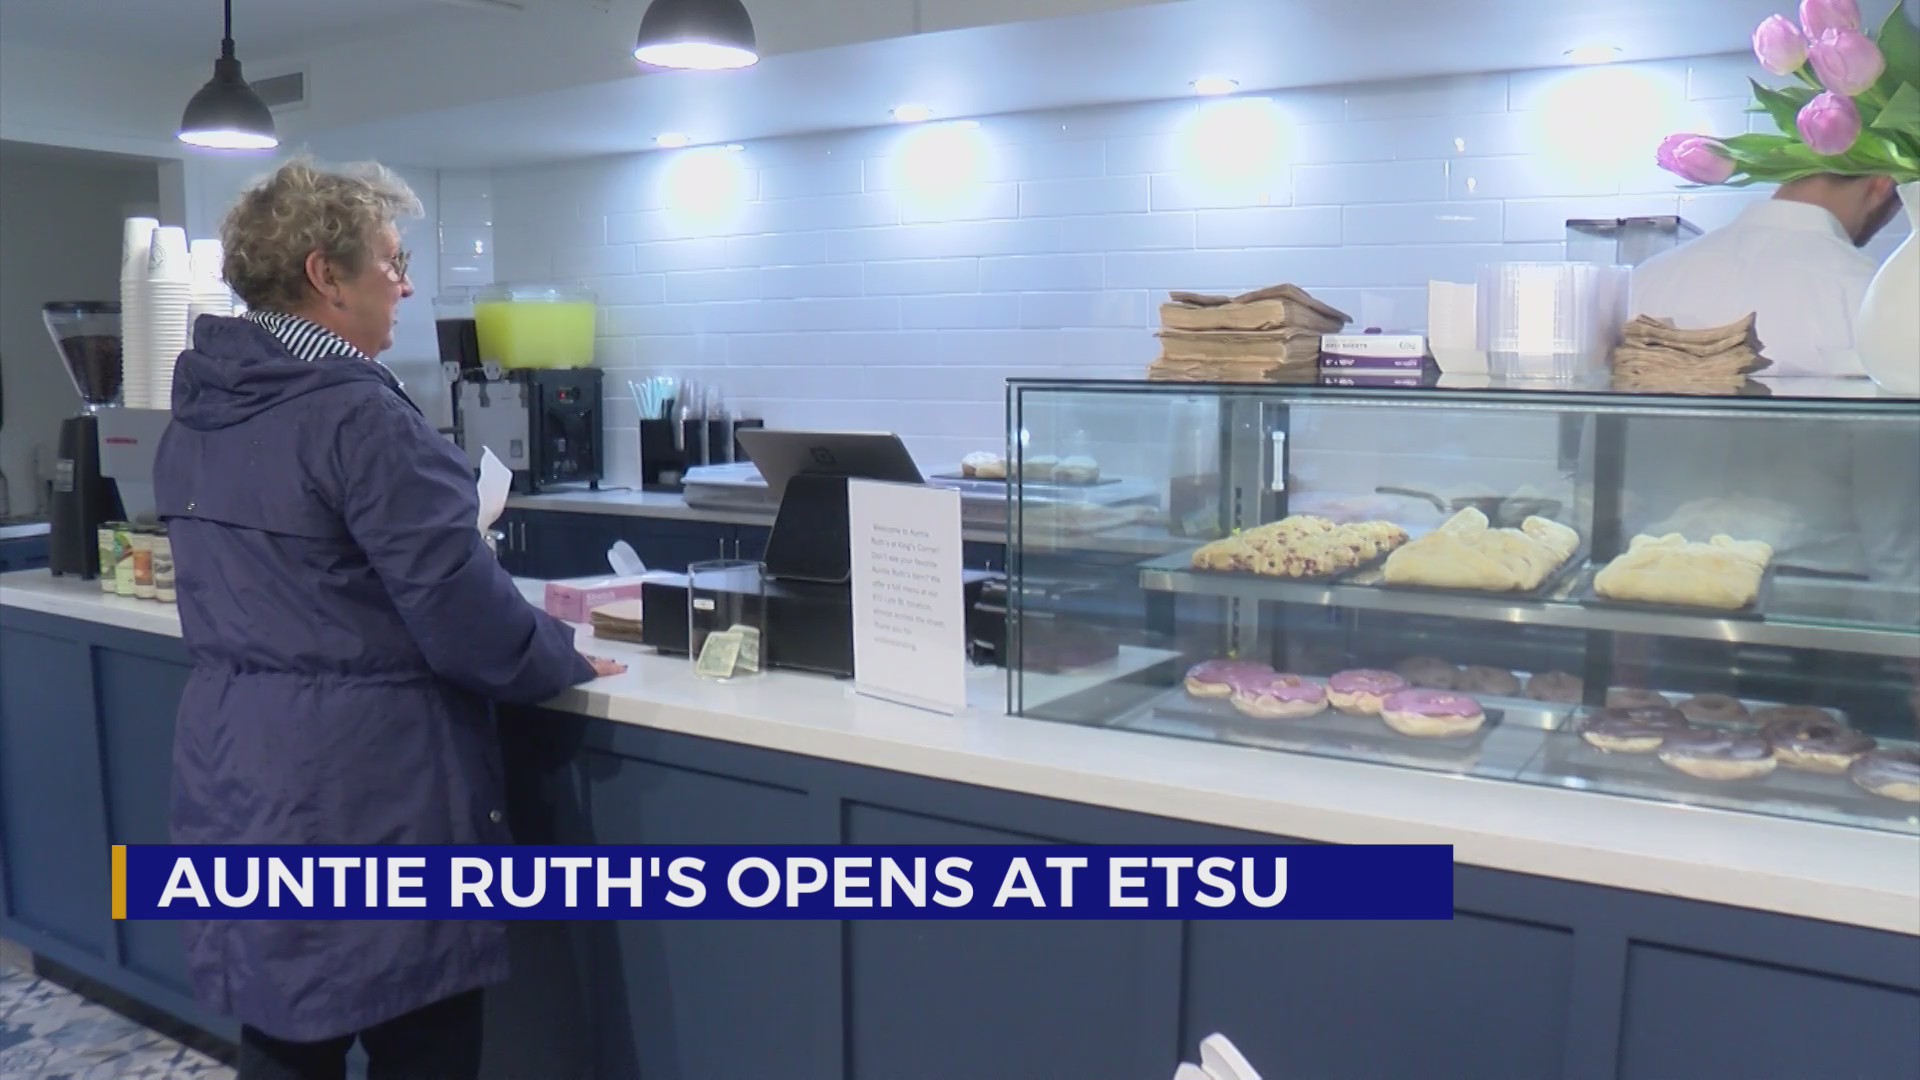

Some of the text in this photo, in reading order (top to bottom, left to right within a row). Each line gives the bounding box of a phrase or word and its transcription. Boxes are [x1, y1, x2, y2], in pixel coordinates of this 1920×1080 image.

[873, 523, 900, 535] Welcome
[910, 528, 929, 538] Auntie
[871, 537, 889, 548] Ruth's
[898, 541, 916, 552] King's
[871, 551, 887, 560] Don't
[900, 558, 913, 566] your
[914, 557, 937, 568] favorite
[872, 566, 890, 576] Auntie
[892, 568, 911, 579] Ruth's
[872, 580, 885, 588] offer
[891, 582, 901, 591] full
[903, 586, 920, 595] menu
[894, 611, 913, 622] across
[915, 615, 925, 624] the
[873, 621, 890, 631] Thank
[903, 627, 912, 635] for
